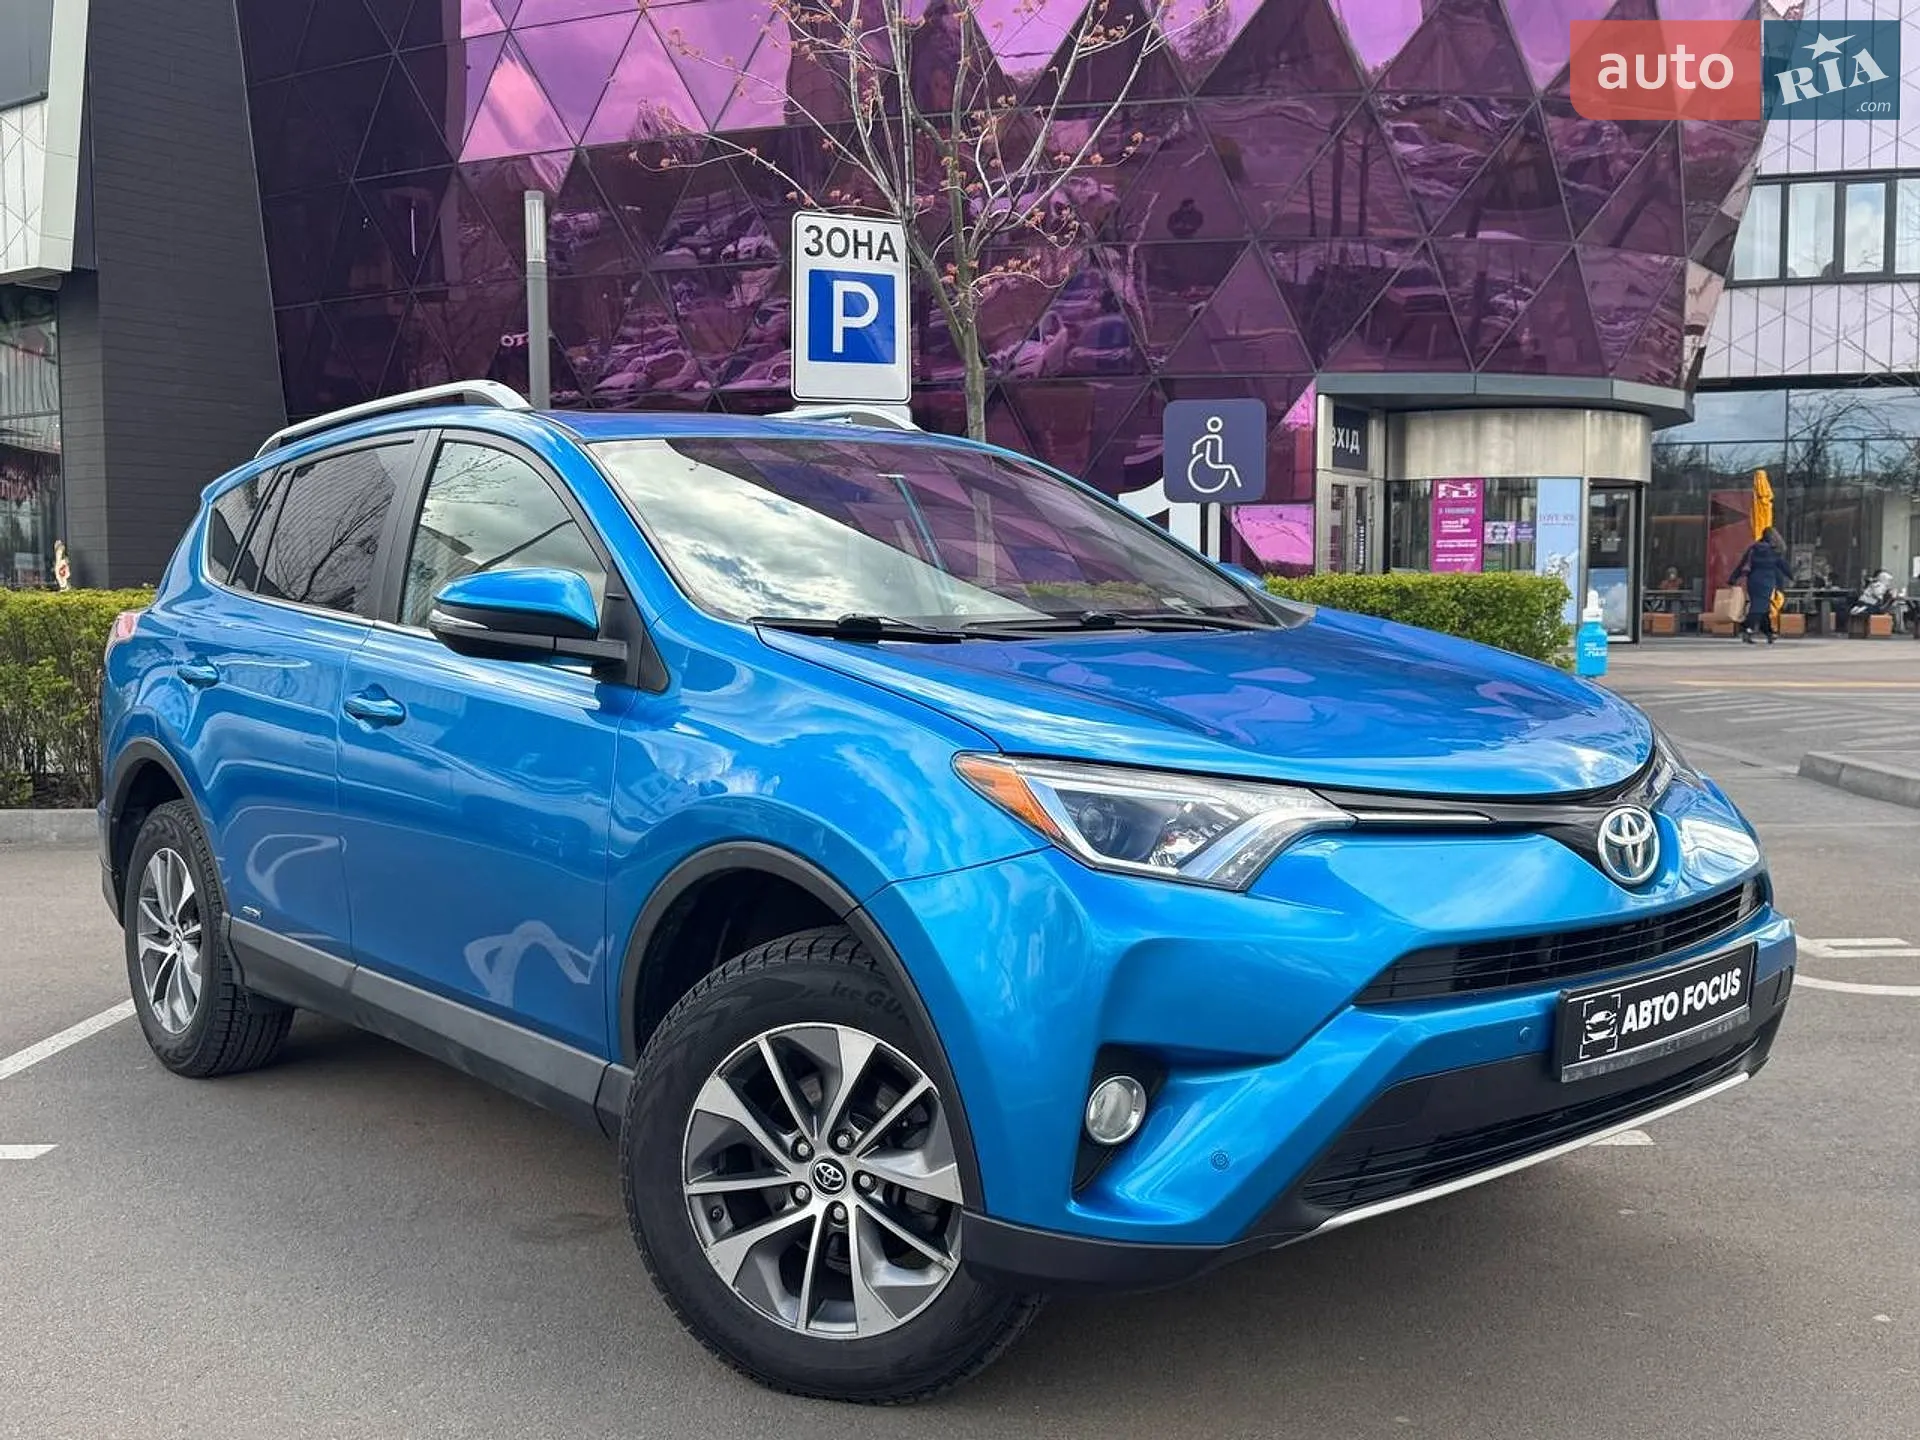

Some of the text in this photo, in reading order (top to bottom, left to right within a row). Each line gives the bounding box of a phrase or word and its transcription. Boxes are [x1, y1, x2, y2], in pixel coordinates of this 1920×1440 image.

[804, 225, 899, 263] ЗОНА
[832, 280, 879, 353] P
[1621, 994, 1680, 1035] АВТО
[1682, 967, 1742, 1016] FOCUS
